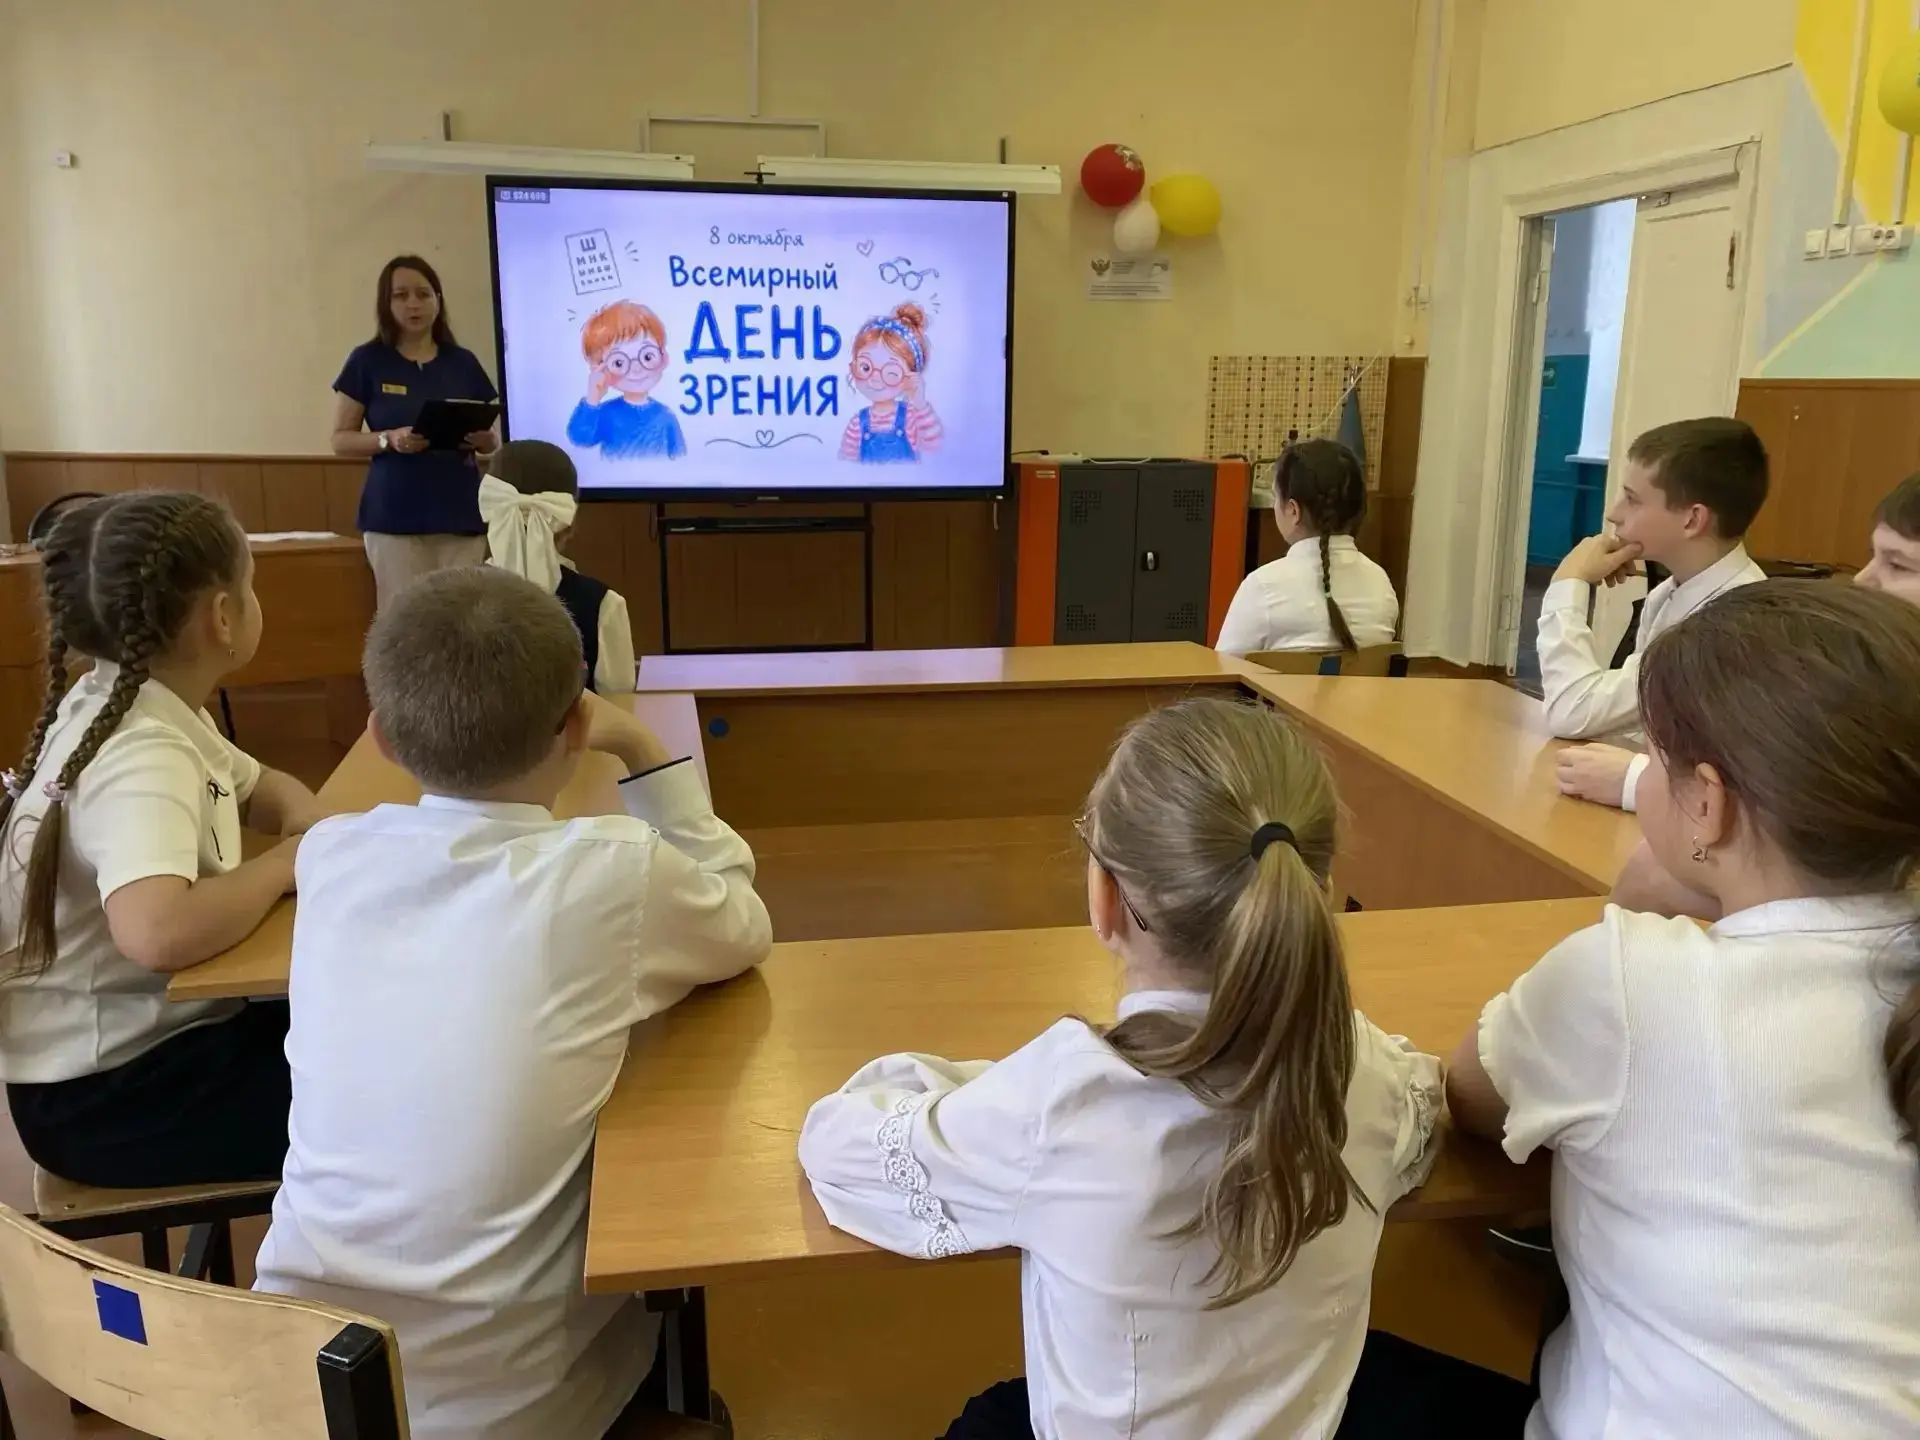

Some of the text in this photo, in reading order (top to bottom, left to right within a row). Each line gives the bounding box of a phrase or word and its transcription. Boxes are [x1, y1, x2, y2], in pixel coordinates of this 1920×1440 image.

[580, 237, 596, 252] Ш
[709, 225, 805, 252] 8 октября
[669, 255, 838, 297] Всемирный
[683, 300, 842, 364] ДЕНЬ
[679, 374, 838, 417] ЗРЕНИЯ
